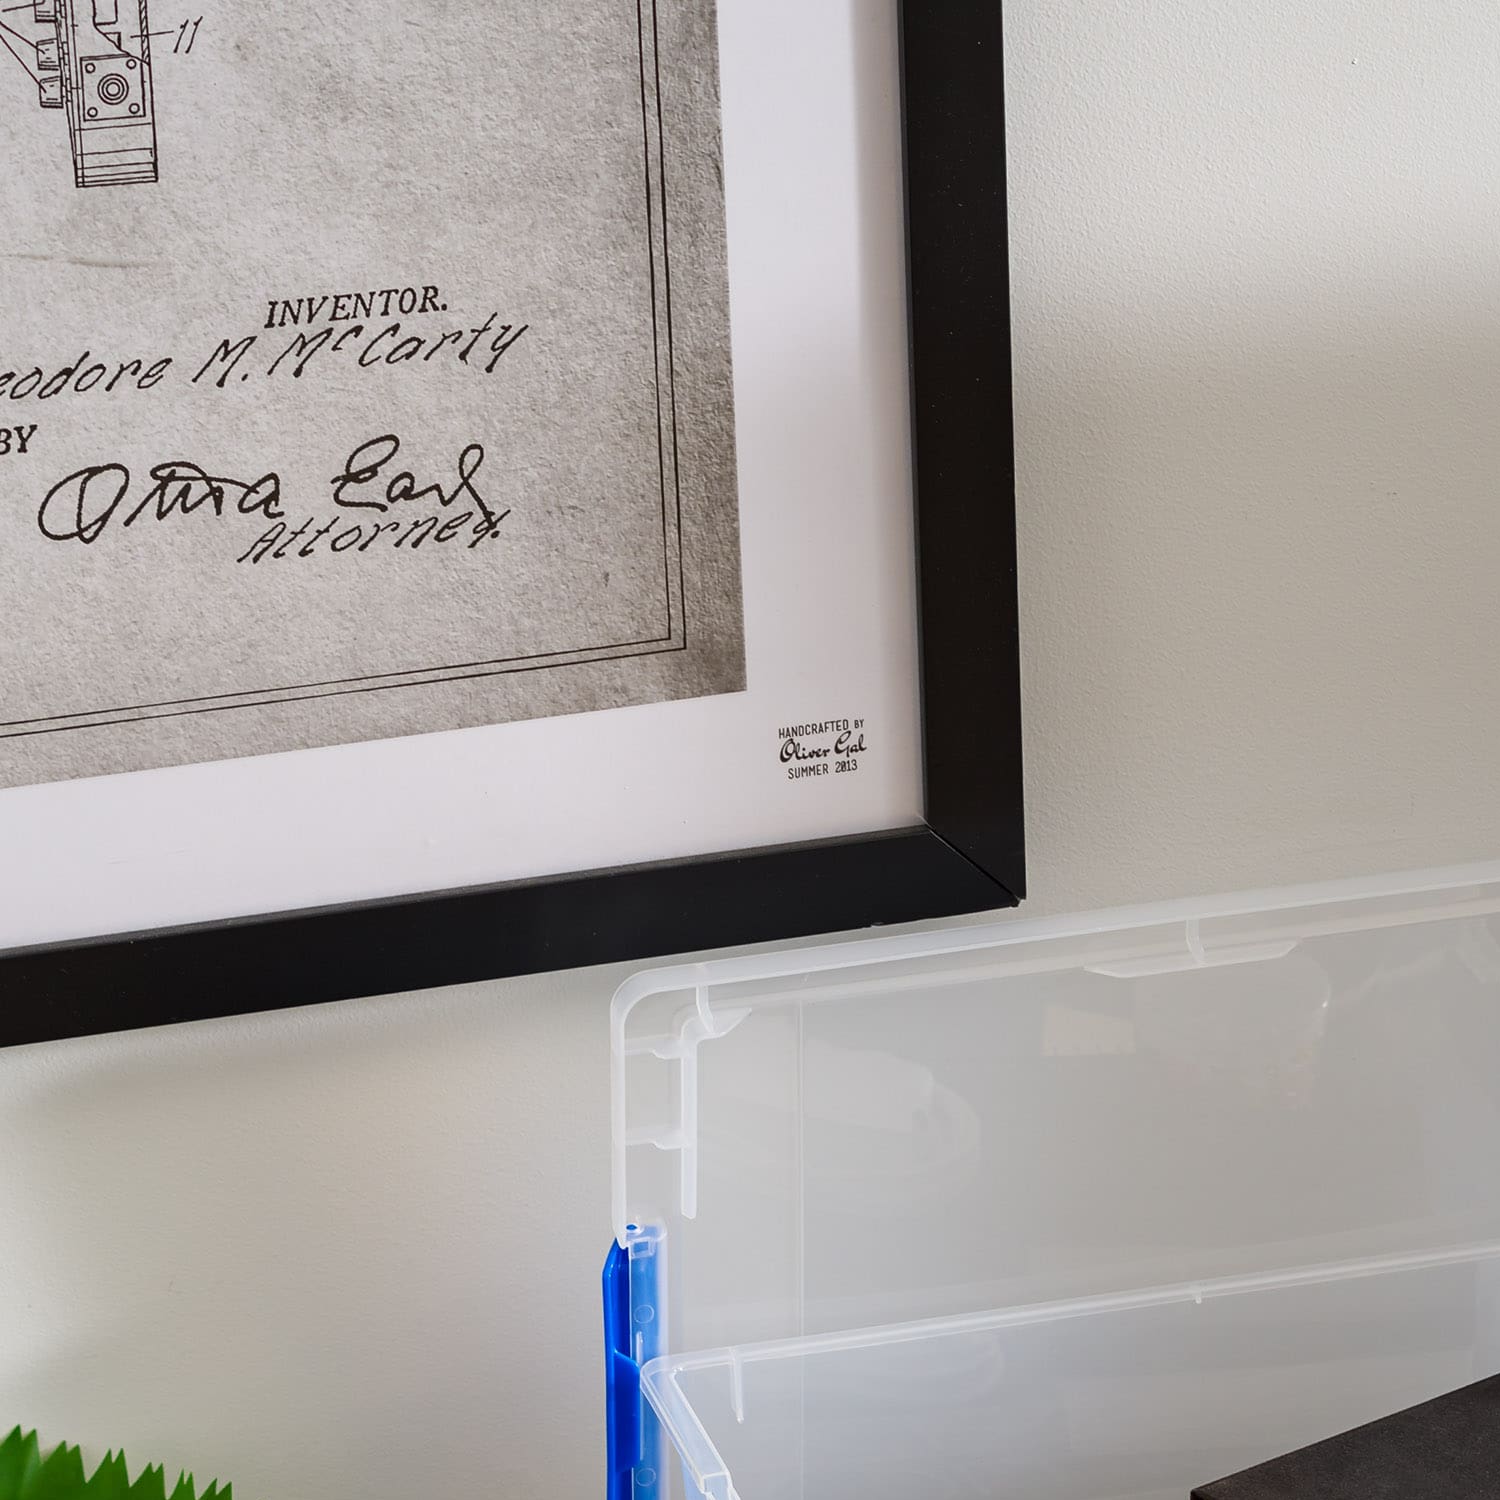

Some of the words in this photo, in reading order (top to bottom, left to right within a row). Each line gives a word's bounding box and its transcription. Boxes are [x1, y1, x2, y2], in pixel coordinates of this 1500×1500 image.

[264, 285, 449, 329] INVENTOR.
[192, 335, 258, 388] M.
[778, 718, 849, 739] HANDCRAFTED
[854, 719, 864, 729] BY
[787, 763, 829, 780] SUMMER
[835, 758, 858, 774] 2013
